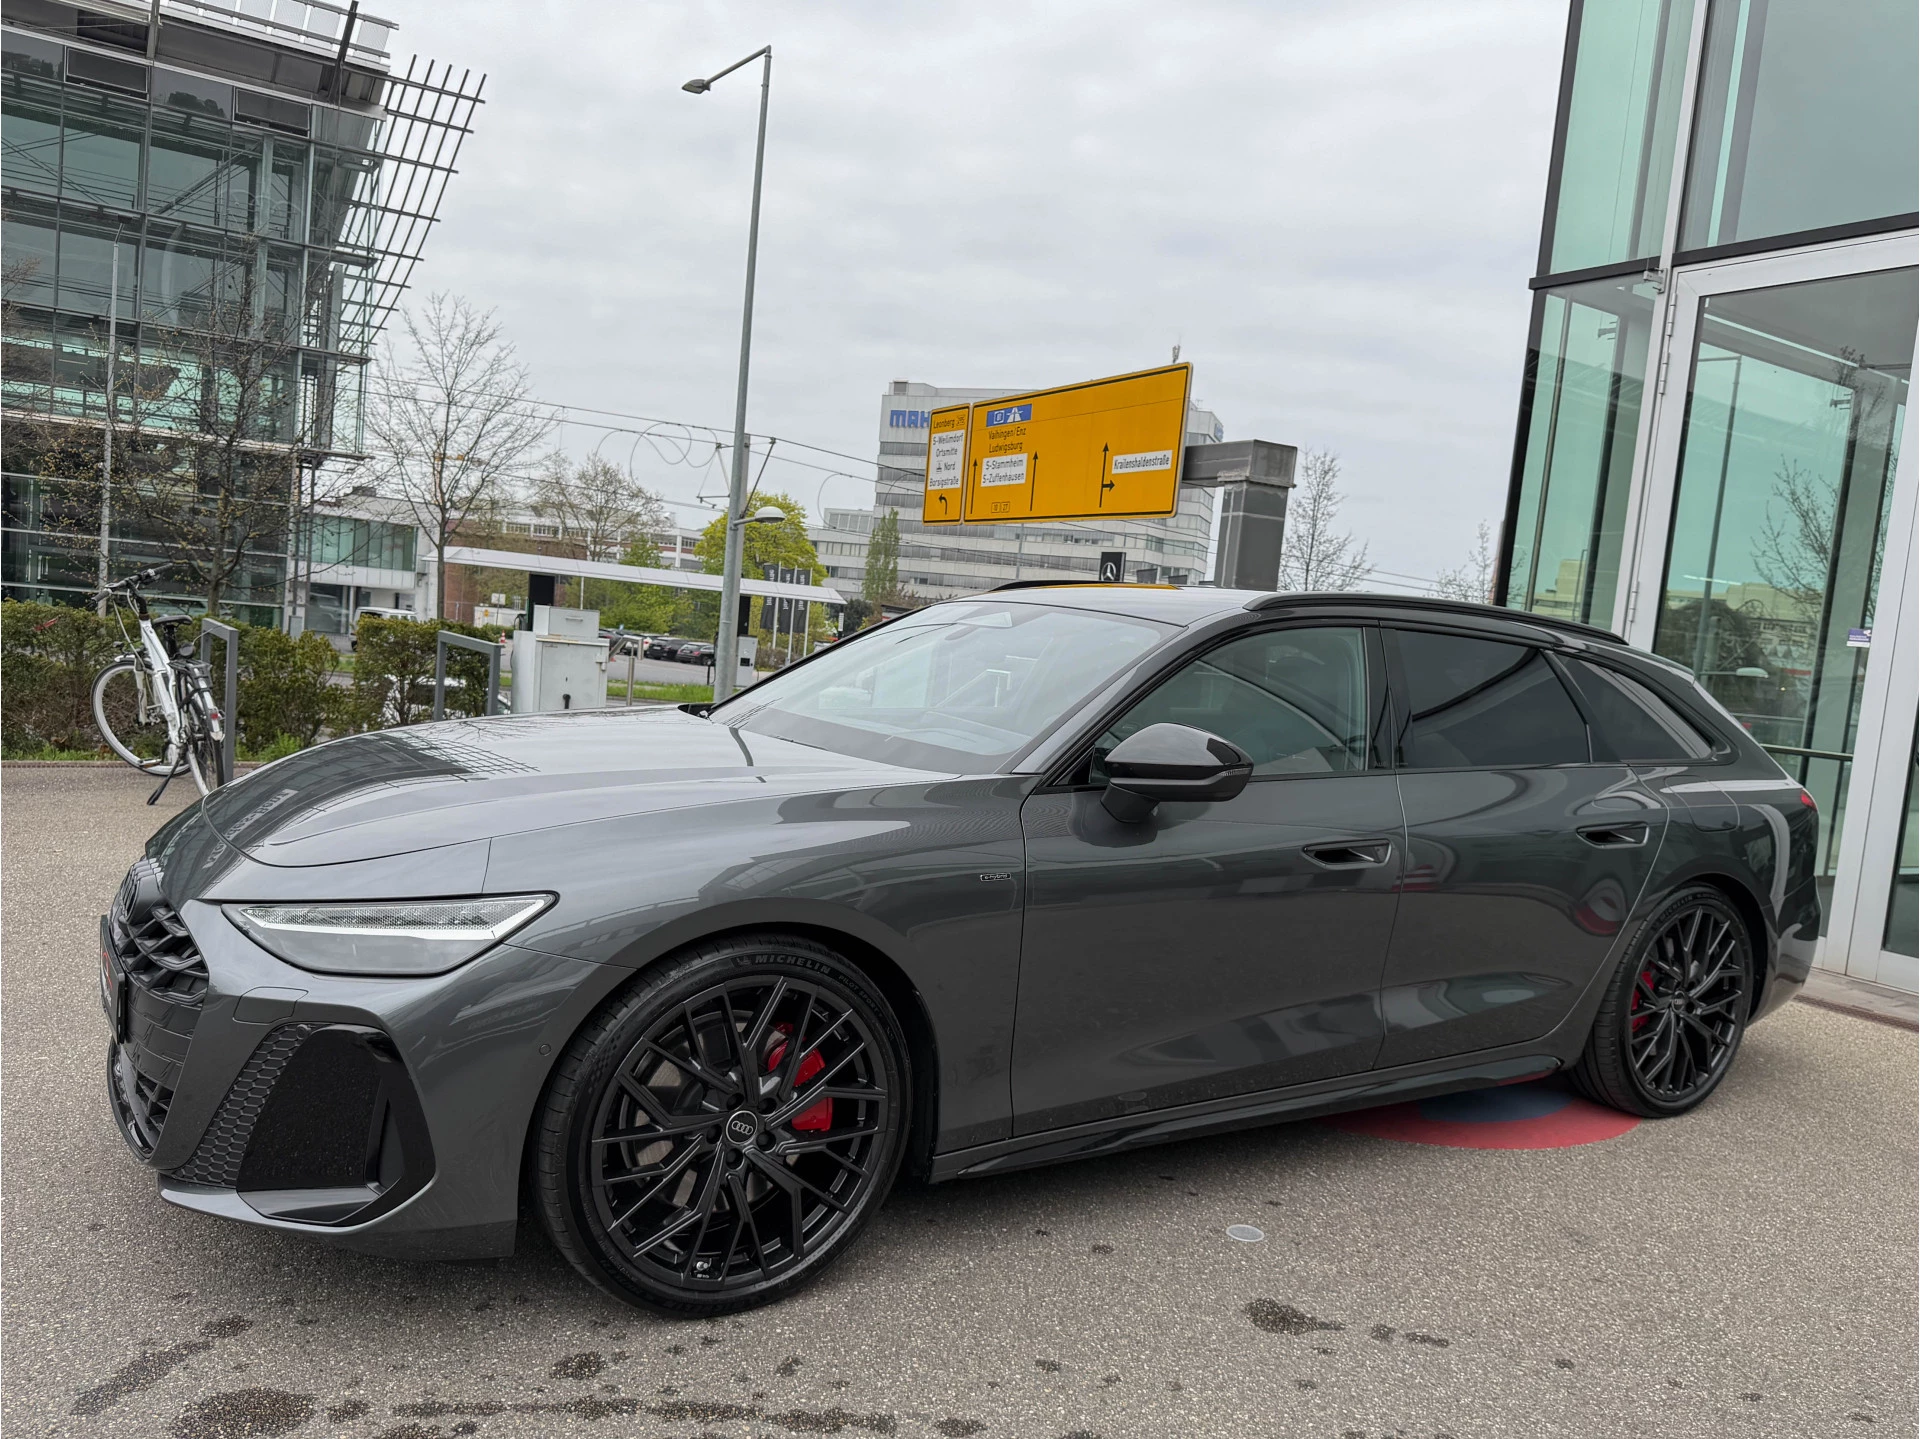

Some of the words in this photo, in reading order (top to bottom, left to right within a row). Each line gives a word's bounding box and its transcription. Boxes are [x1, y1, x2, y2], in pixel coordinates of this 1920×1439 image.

[933, 419, 955, 429] Leonberg
[932, 432, 964, 446] S-Weilimdorf
[988, 426, 1026, 440] Vaihingen/Enz
[935, 447, 958, 458] Ortsmitte
[988, 441, 1023, 453] Ludwigsburg
[944, 461, 956, 471] Nord
[985, 459, 1024, 471] S-Stammheim
[1114, 454, 1170, 469] Krailenshaldenstraße
[929, 476, 959, 488] Borsigstraße
[982, 472, 1025, 484] S-Zuffenhausen
[755, 954, 832, 975] MICHELIN
[839, 975, 858, 991] PILOT
[860, 991, 880, 1013] SPORT
